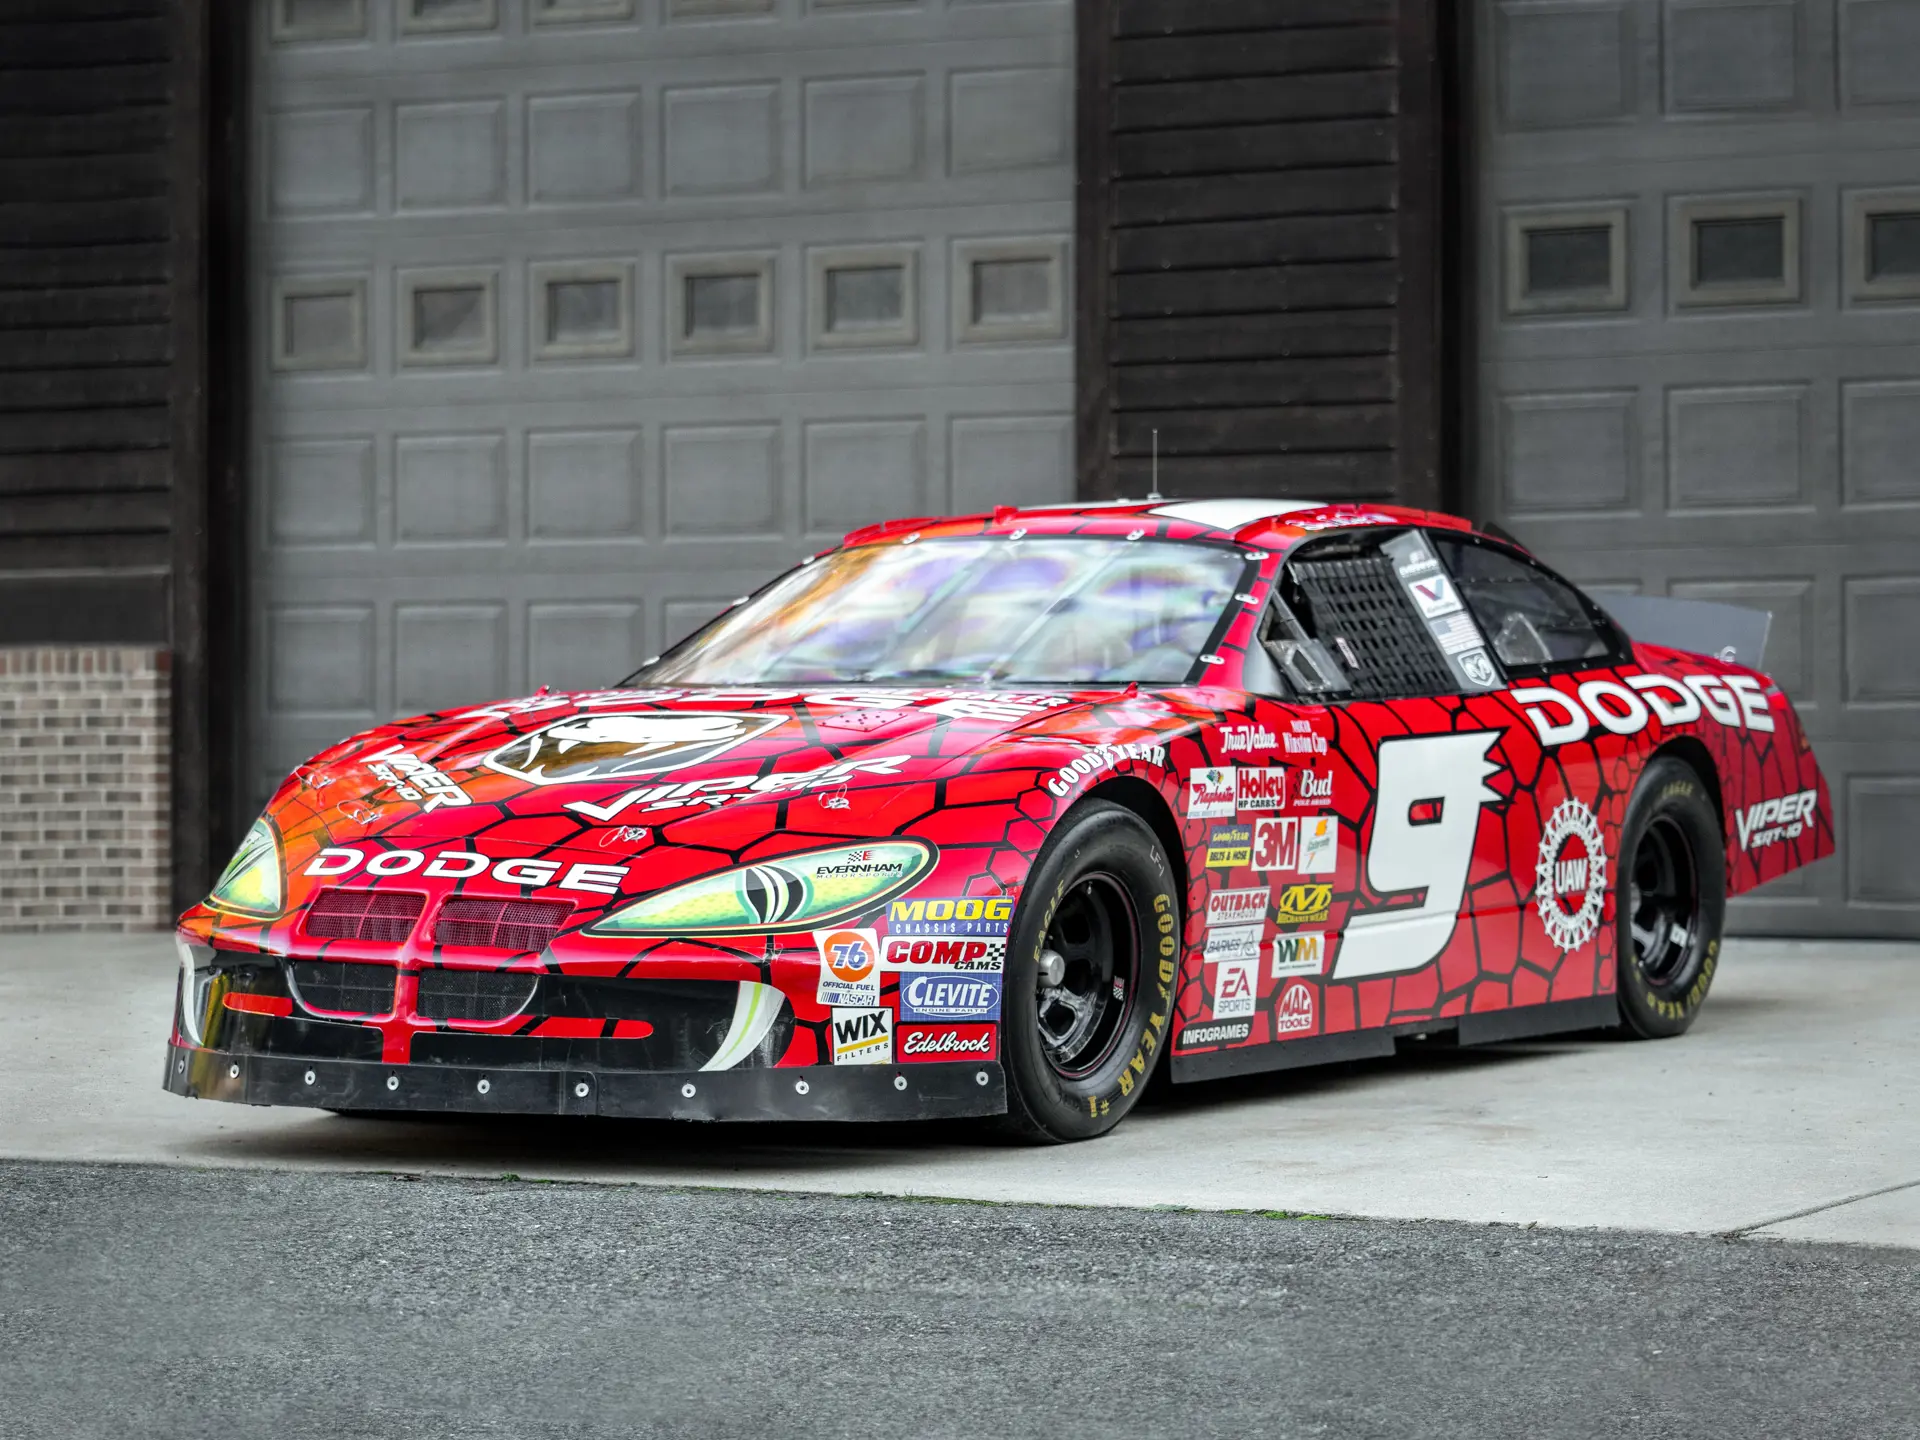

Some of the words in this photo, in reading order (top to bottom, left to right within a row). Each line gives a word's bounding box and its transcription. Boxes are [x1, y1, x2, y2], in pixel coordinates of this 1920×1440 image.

[1510, 674, 1775, 746] DODGE
[360, 743, 473, 814] VIPER
[1047, 743, 1166, 797] GOODYEAR
[1301, 769, 1333, 798] Bud
[562, 755, 911, 821] VIPER
[1239, 769, 1285, 807] Holley
[1238, 800, 1249, 809] HP
[1250, 799, 1276, 808] CARBS
[1735, 789, 1817, 852] VIPER
[1255, 821, 1296, 868] 3M
[1332, 731, 1504, 980] 9
[303, 848, 630, 894] DODGE
[816, 863, 903, 875] EVERNHAM
[816, 871, 903, 879] MOTORSPORTS
[1555, 857, 1588, 894] UAW
[889, 898, 1013, 922] MOOG
[1211, 892, 1267, 912] OUTBACK
[895, 922, 957, 934] CHASSIS
[967, 922, 1009, 933] PARTS
[831, 941, 869, 970] 76
[886, 941, 987, 965] COMP
[1277, 937, 1317, 963] WM
[953, 960, 1002, 971] CAMS
[822, 981, 855, 989] OFFICIAL
[856, 982, 875, 991] FUEL
[908, 976, 992, 1007] CLEVITE
[1118, 894, 1175, 1096] GOODYEAR
[1220, 967, 1251, 999] EA
[1218, 998, 1251, 1014] SPORTS
[835, 1010, 888, 1044] WIX
[1183, 1023, 1250, 1045] INFOGRAMES
[1280, 1016, 1310, 1029] TOOLS
[837, 1042, 889, 1062] FILTERS
[903, 1031, 991, 1055] Edelbrock
